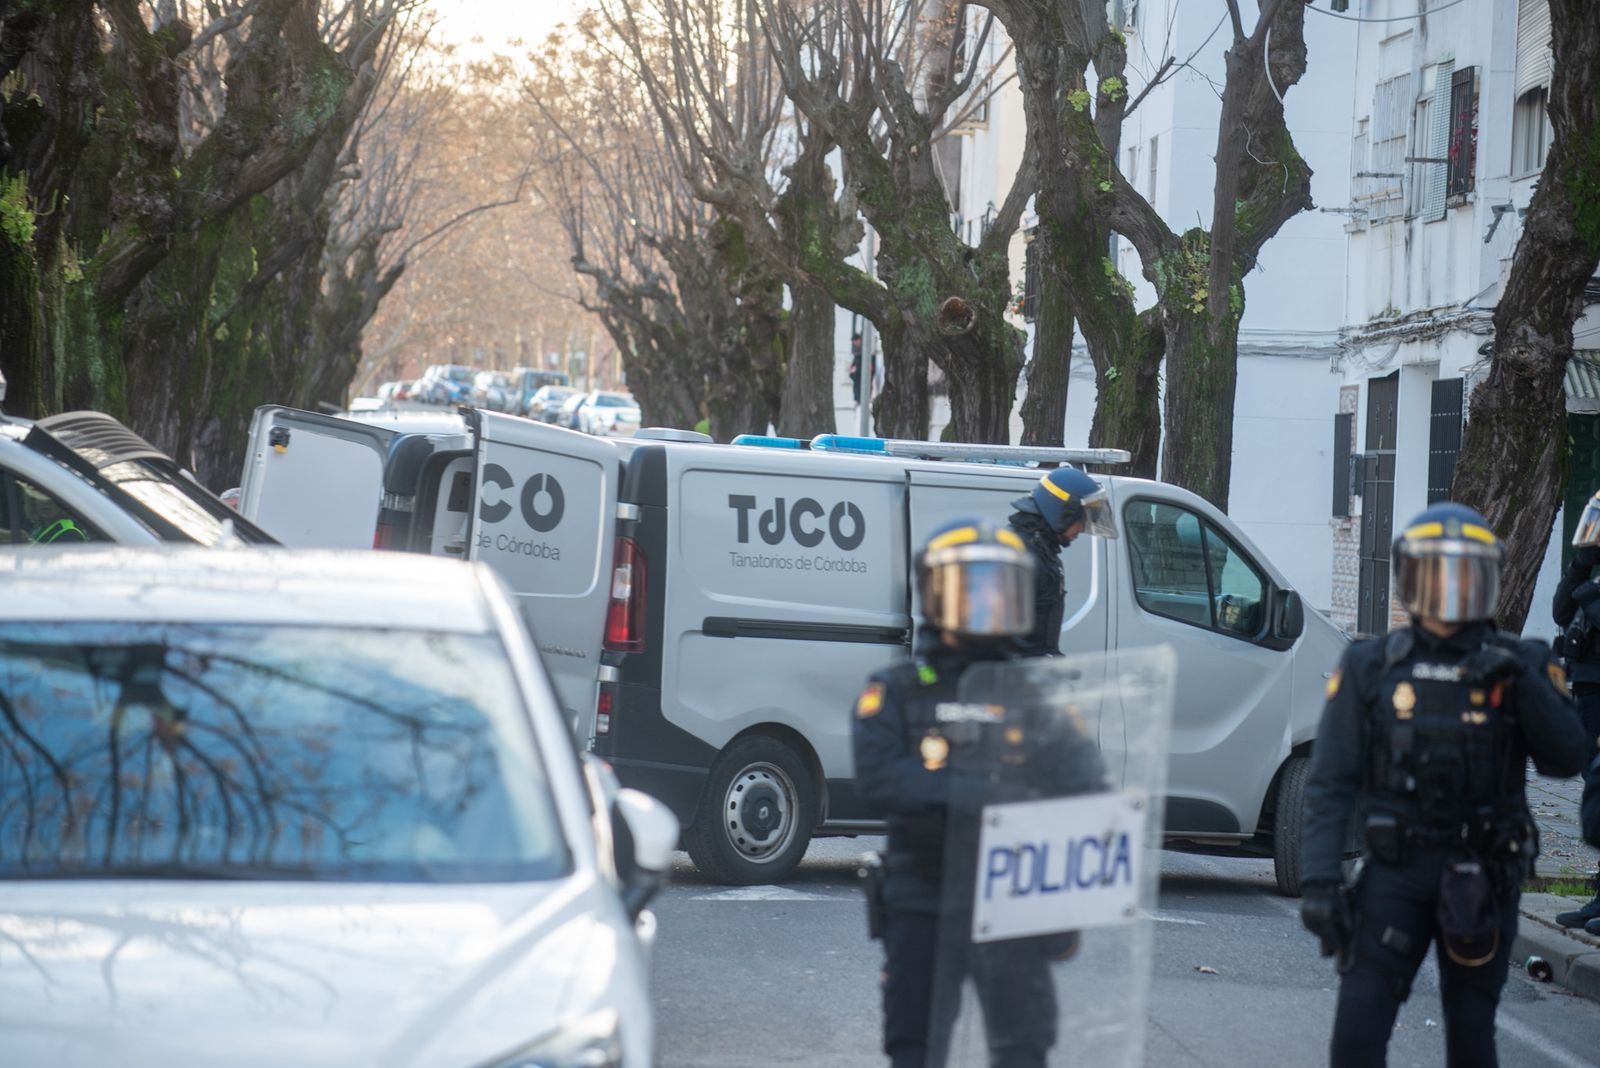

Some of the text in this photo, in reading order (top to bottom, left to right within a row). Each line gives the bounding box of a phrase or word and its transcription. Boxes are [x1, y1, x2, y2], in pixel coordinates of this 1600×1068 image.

[496, 533, 561, 560] Córdoba
[729, 551, 868, 573] Tanatorios de Córdoba
